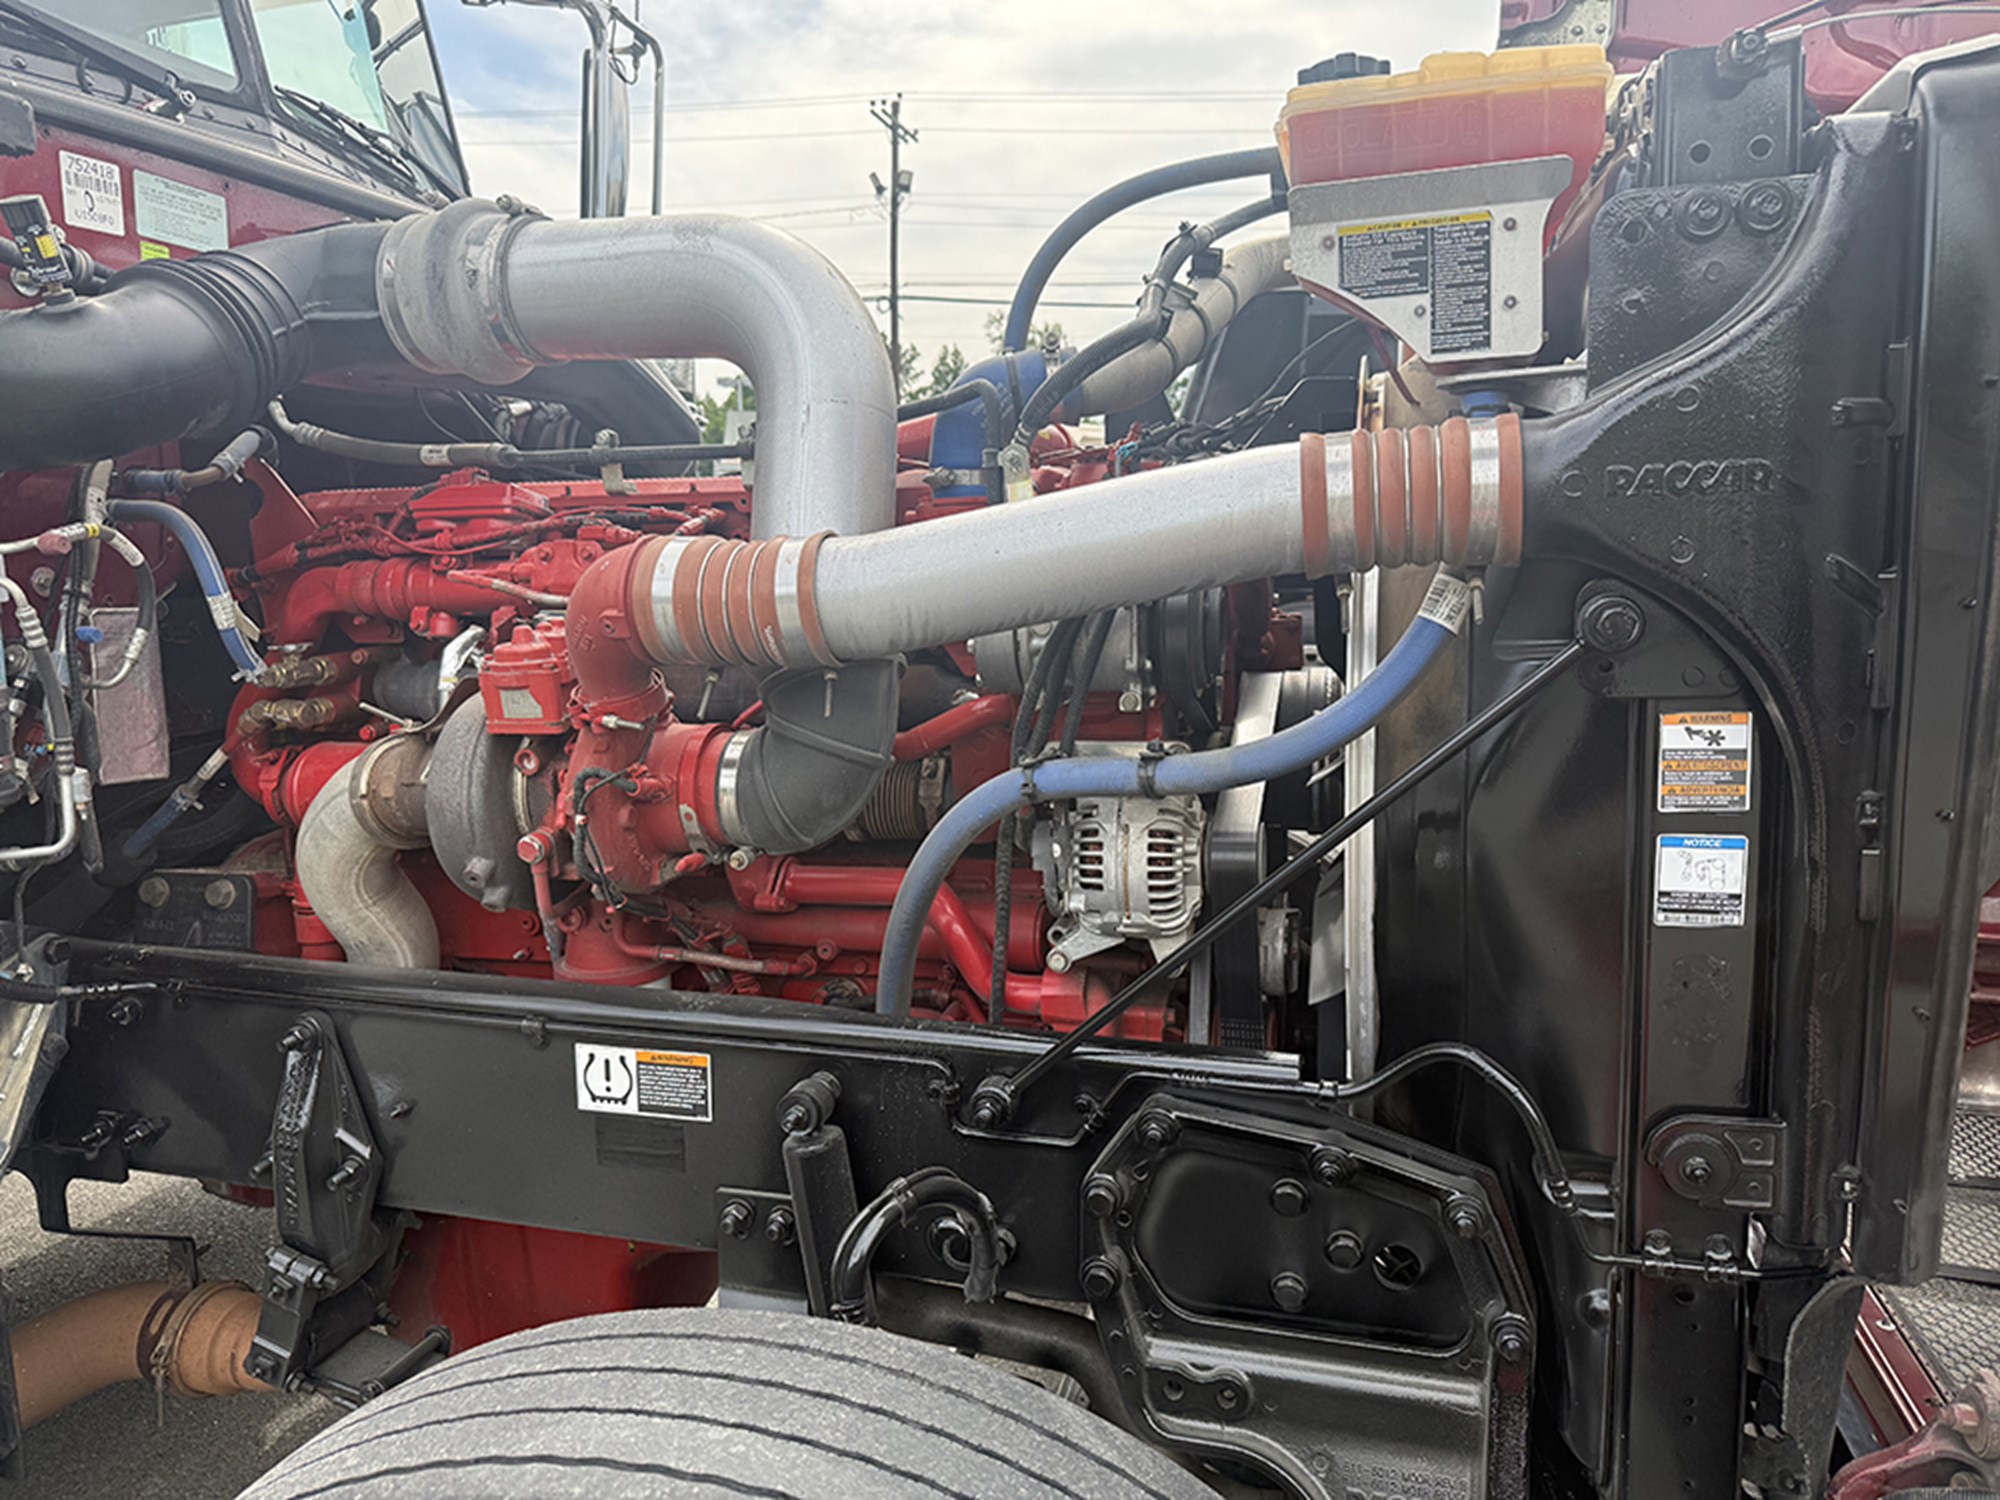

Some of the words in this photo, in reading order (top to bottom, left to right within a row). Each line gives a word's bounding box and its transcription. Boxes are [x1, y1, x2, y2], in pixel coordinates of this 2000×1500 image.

[65, 155, 115, 180] 752418
[1605, 457, 1774, 501] PACCAR
[1683, 838, 1722, 847] NOTICE
